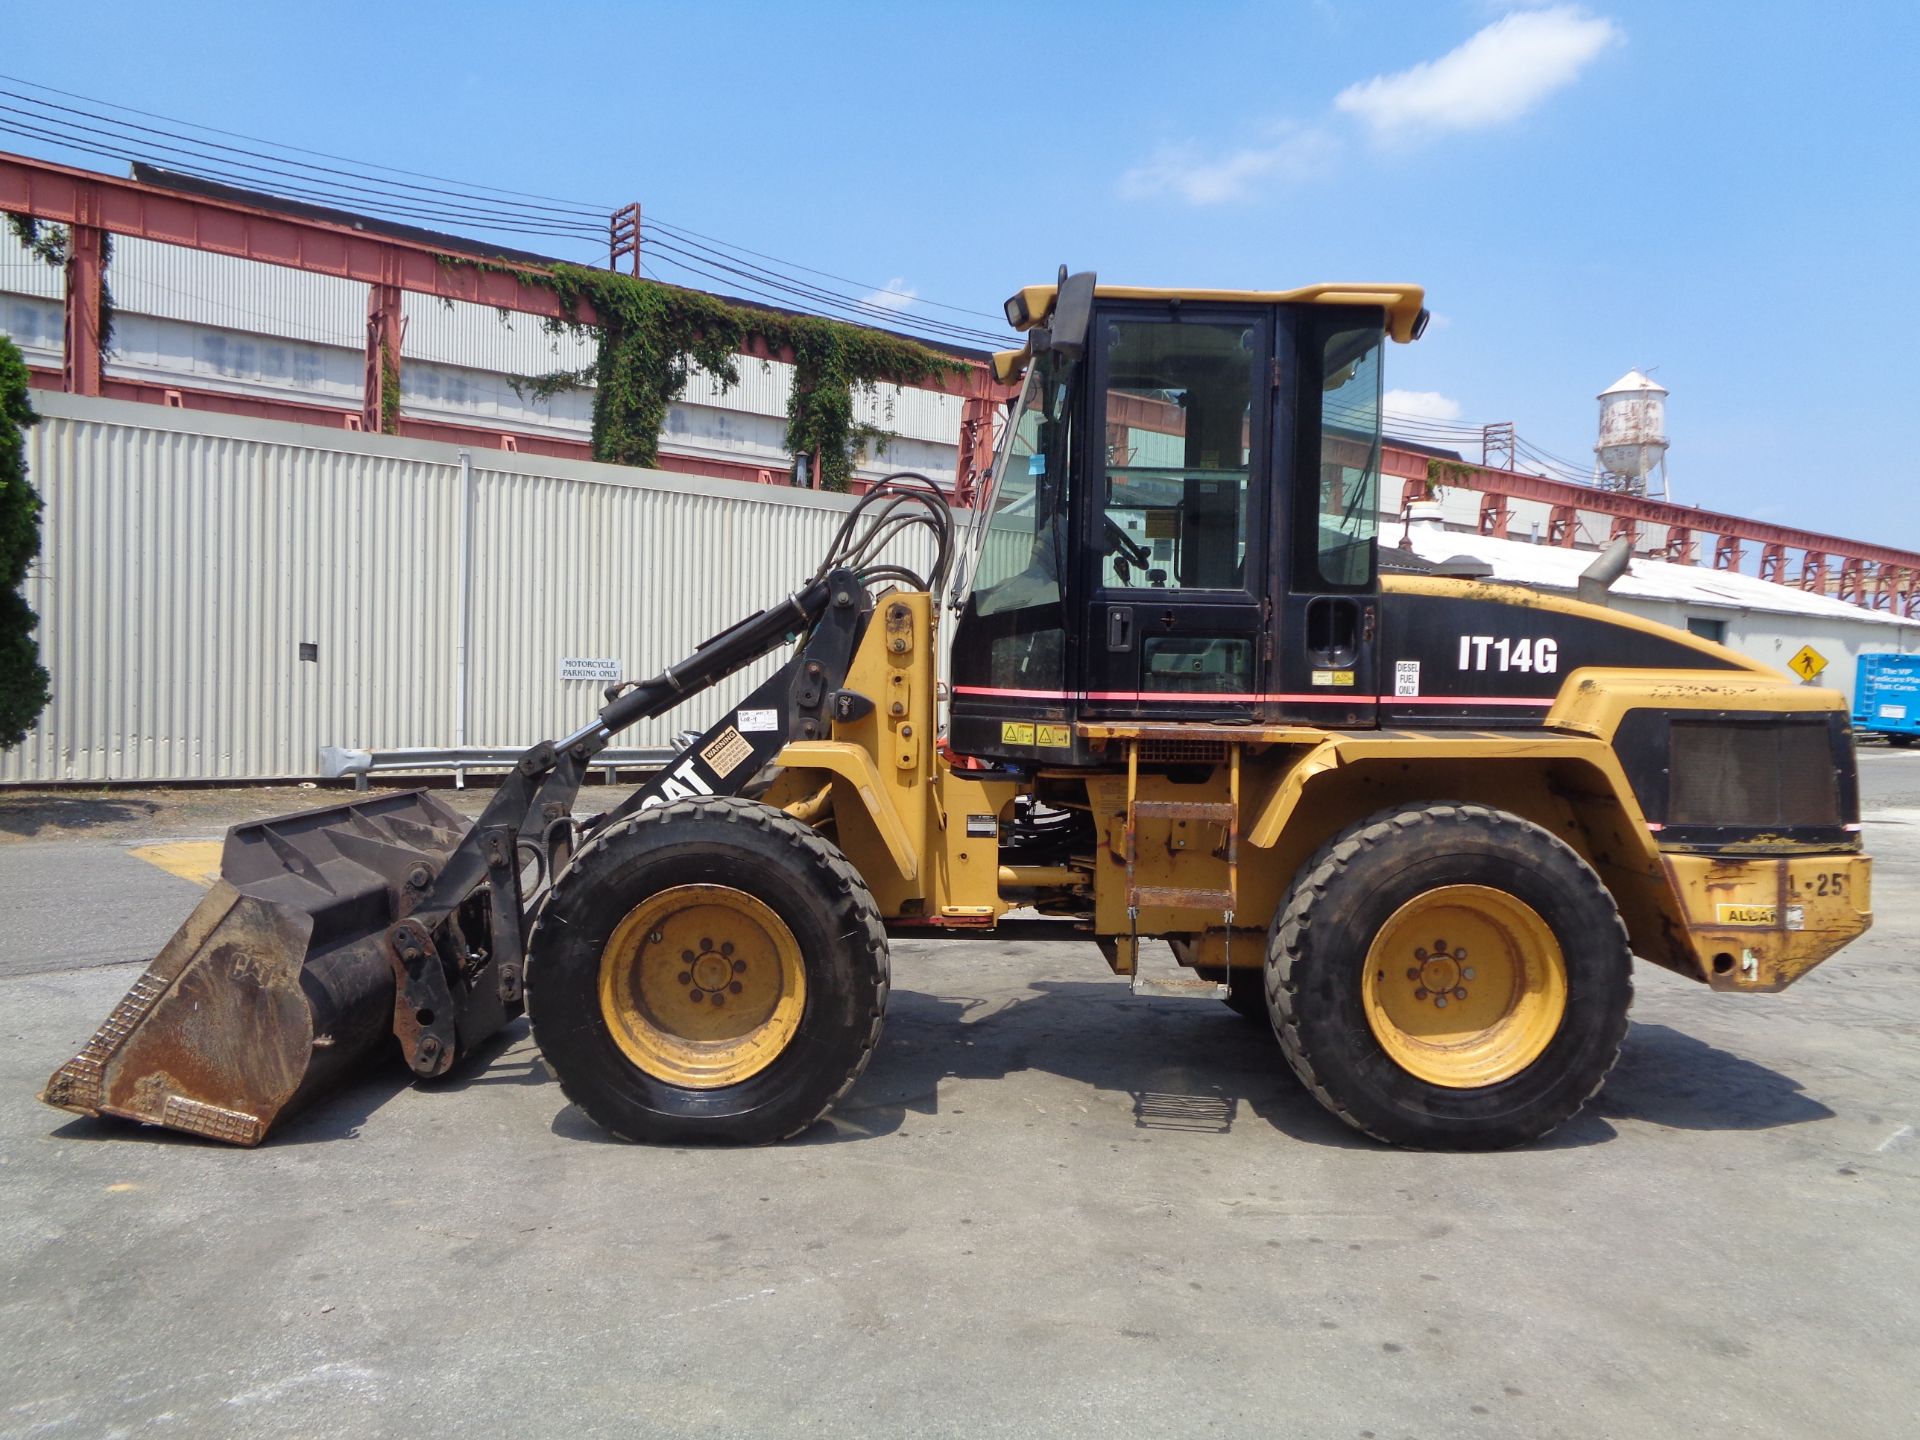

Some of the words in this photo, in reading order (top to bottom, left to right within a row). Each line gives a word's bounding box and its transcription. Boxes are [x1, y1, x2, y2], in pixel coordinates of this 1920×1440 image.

[1458, 635, 1558, 673] IT14G
[565, 660, 615, 668] MOTORCYCLE
[1397, 663, 1419, 672] DIESEL
[562, 669, 597, 677] PARKING
[1399, 674, 1416, 684] FUEL
[1398, 685, 1415, 695] ONLY
[705, 731, 737, 760] WARNING
